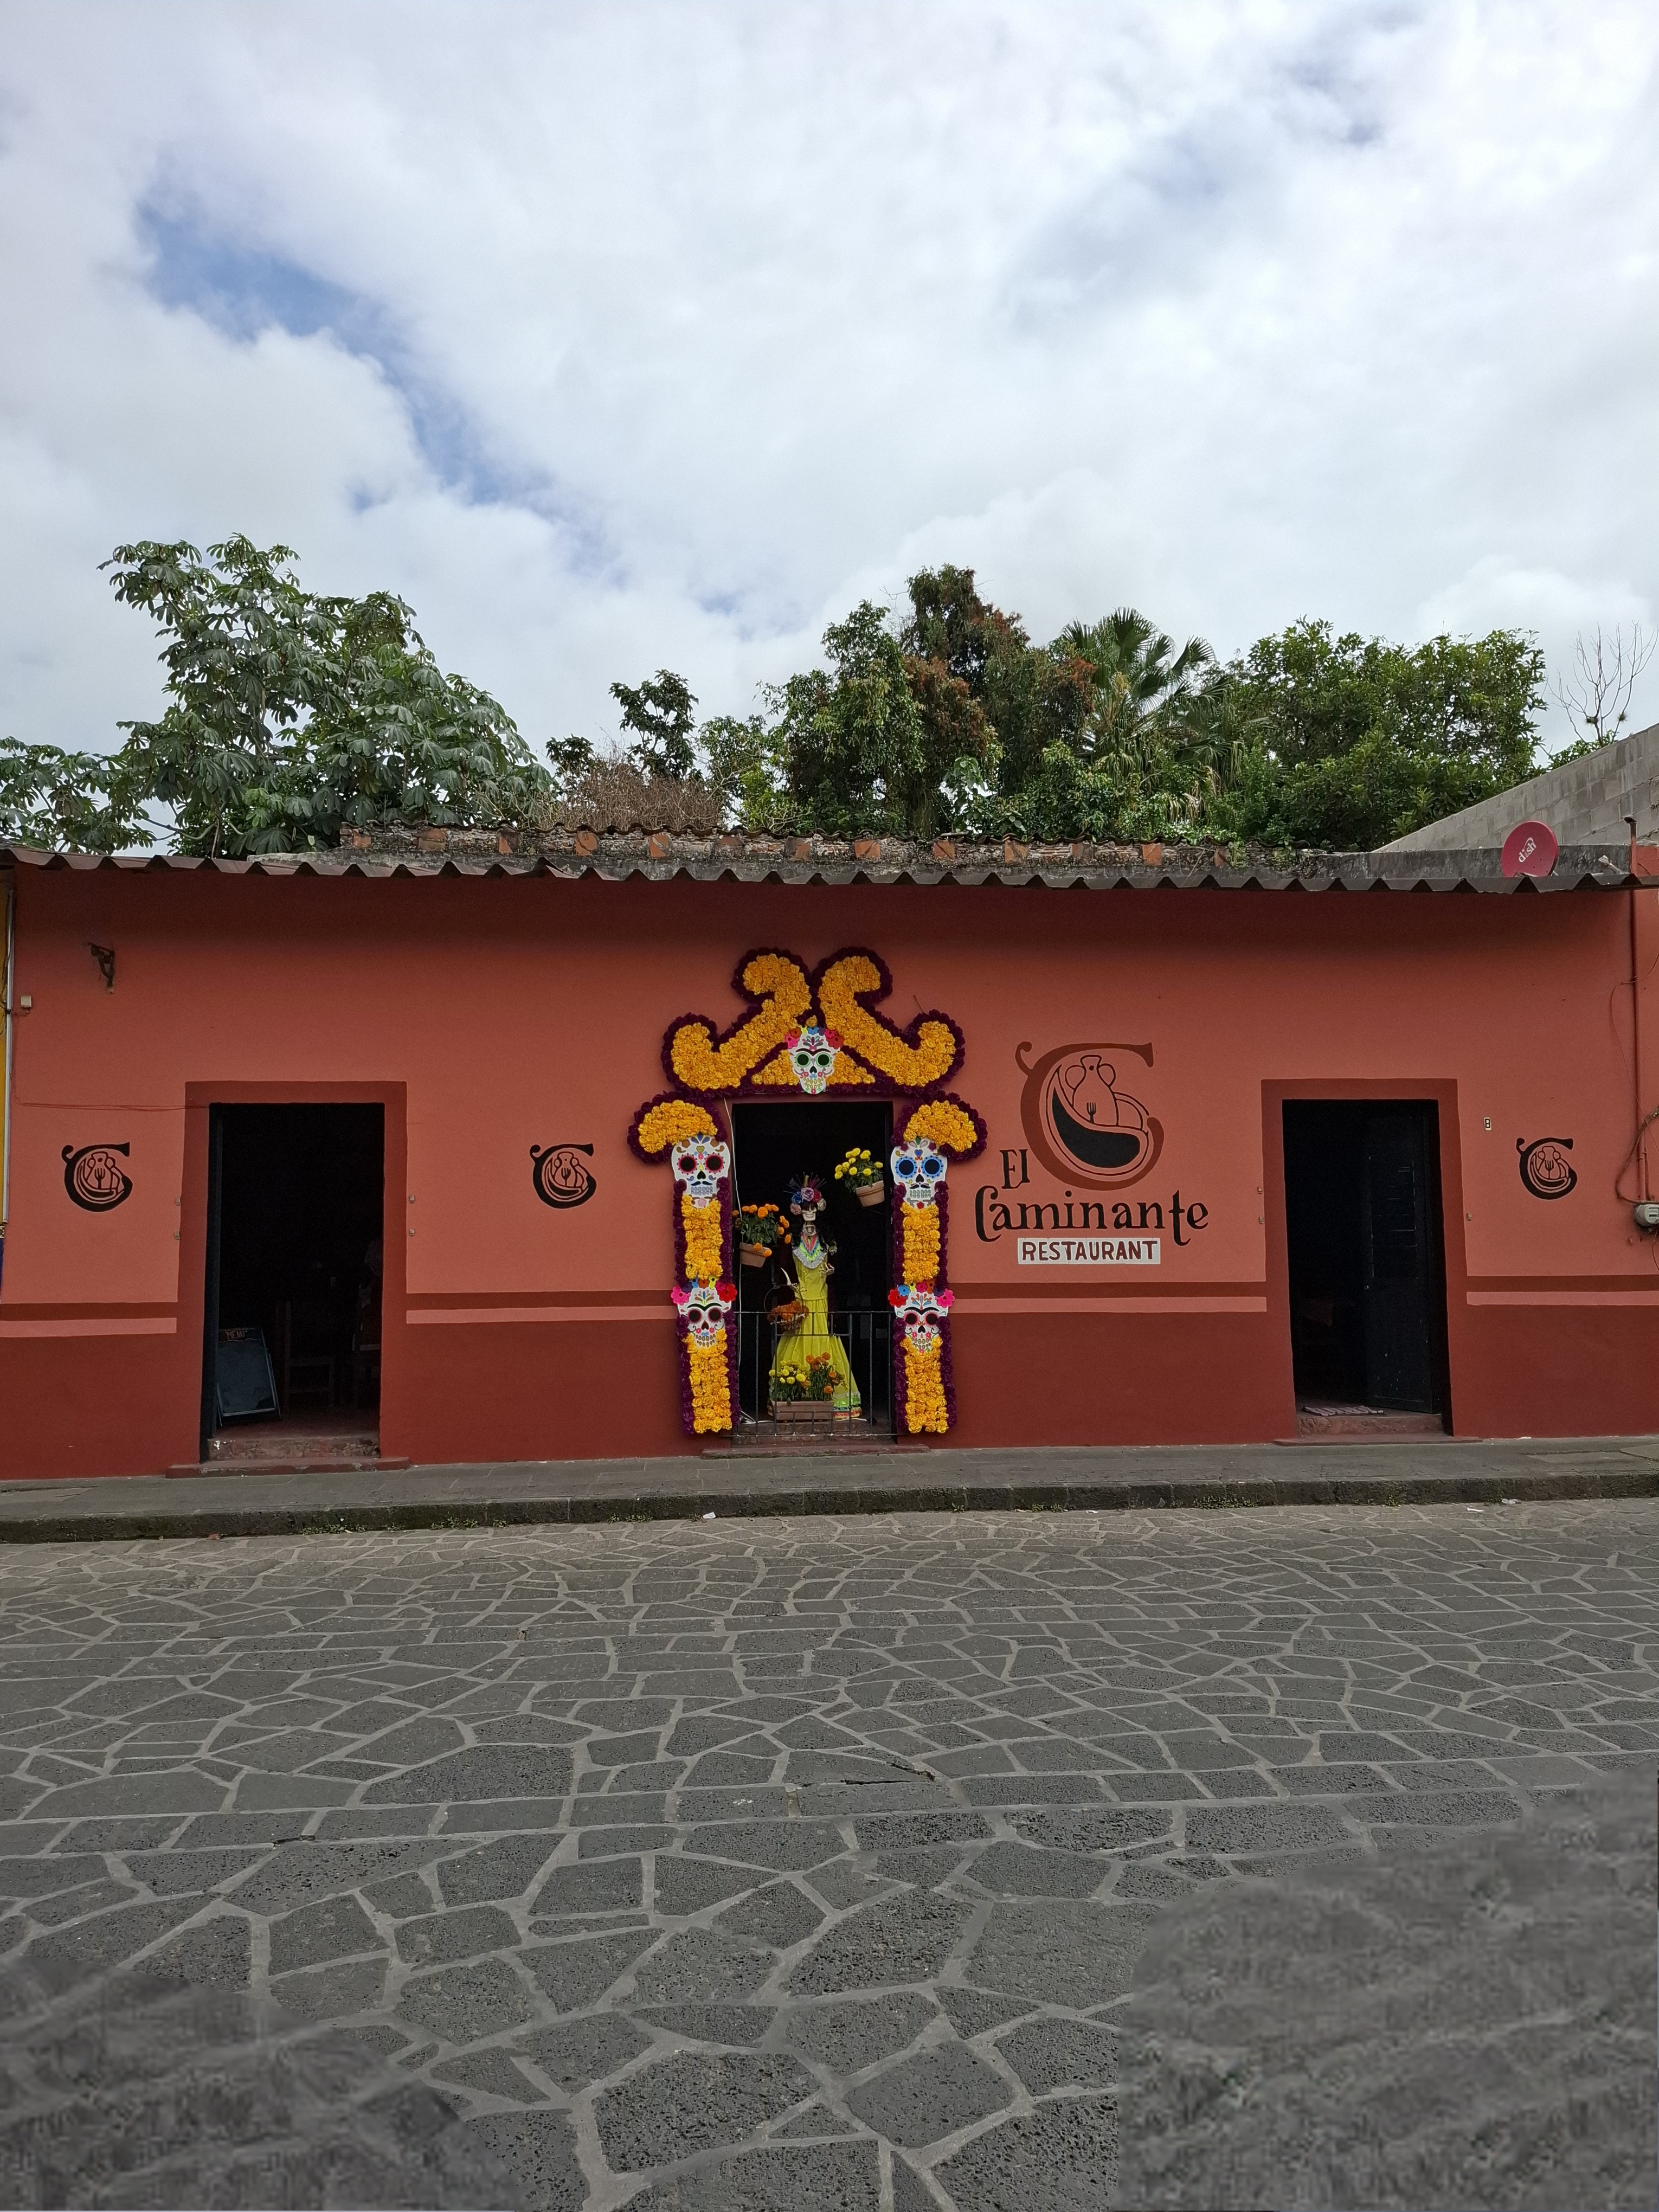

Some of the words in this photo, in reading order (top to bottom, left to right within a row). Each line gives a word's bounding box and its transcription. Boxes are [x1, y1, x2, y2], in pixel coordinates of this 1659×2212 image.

[1519, 837, 1536, 862] dish
[999, 1149, 1030, 1189] El
[975, 1185, 1208, 1246] Caminante
[1022, 1240, 1158, 1261] RESTAURANT
